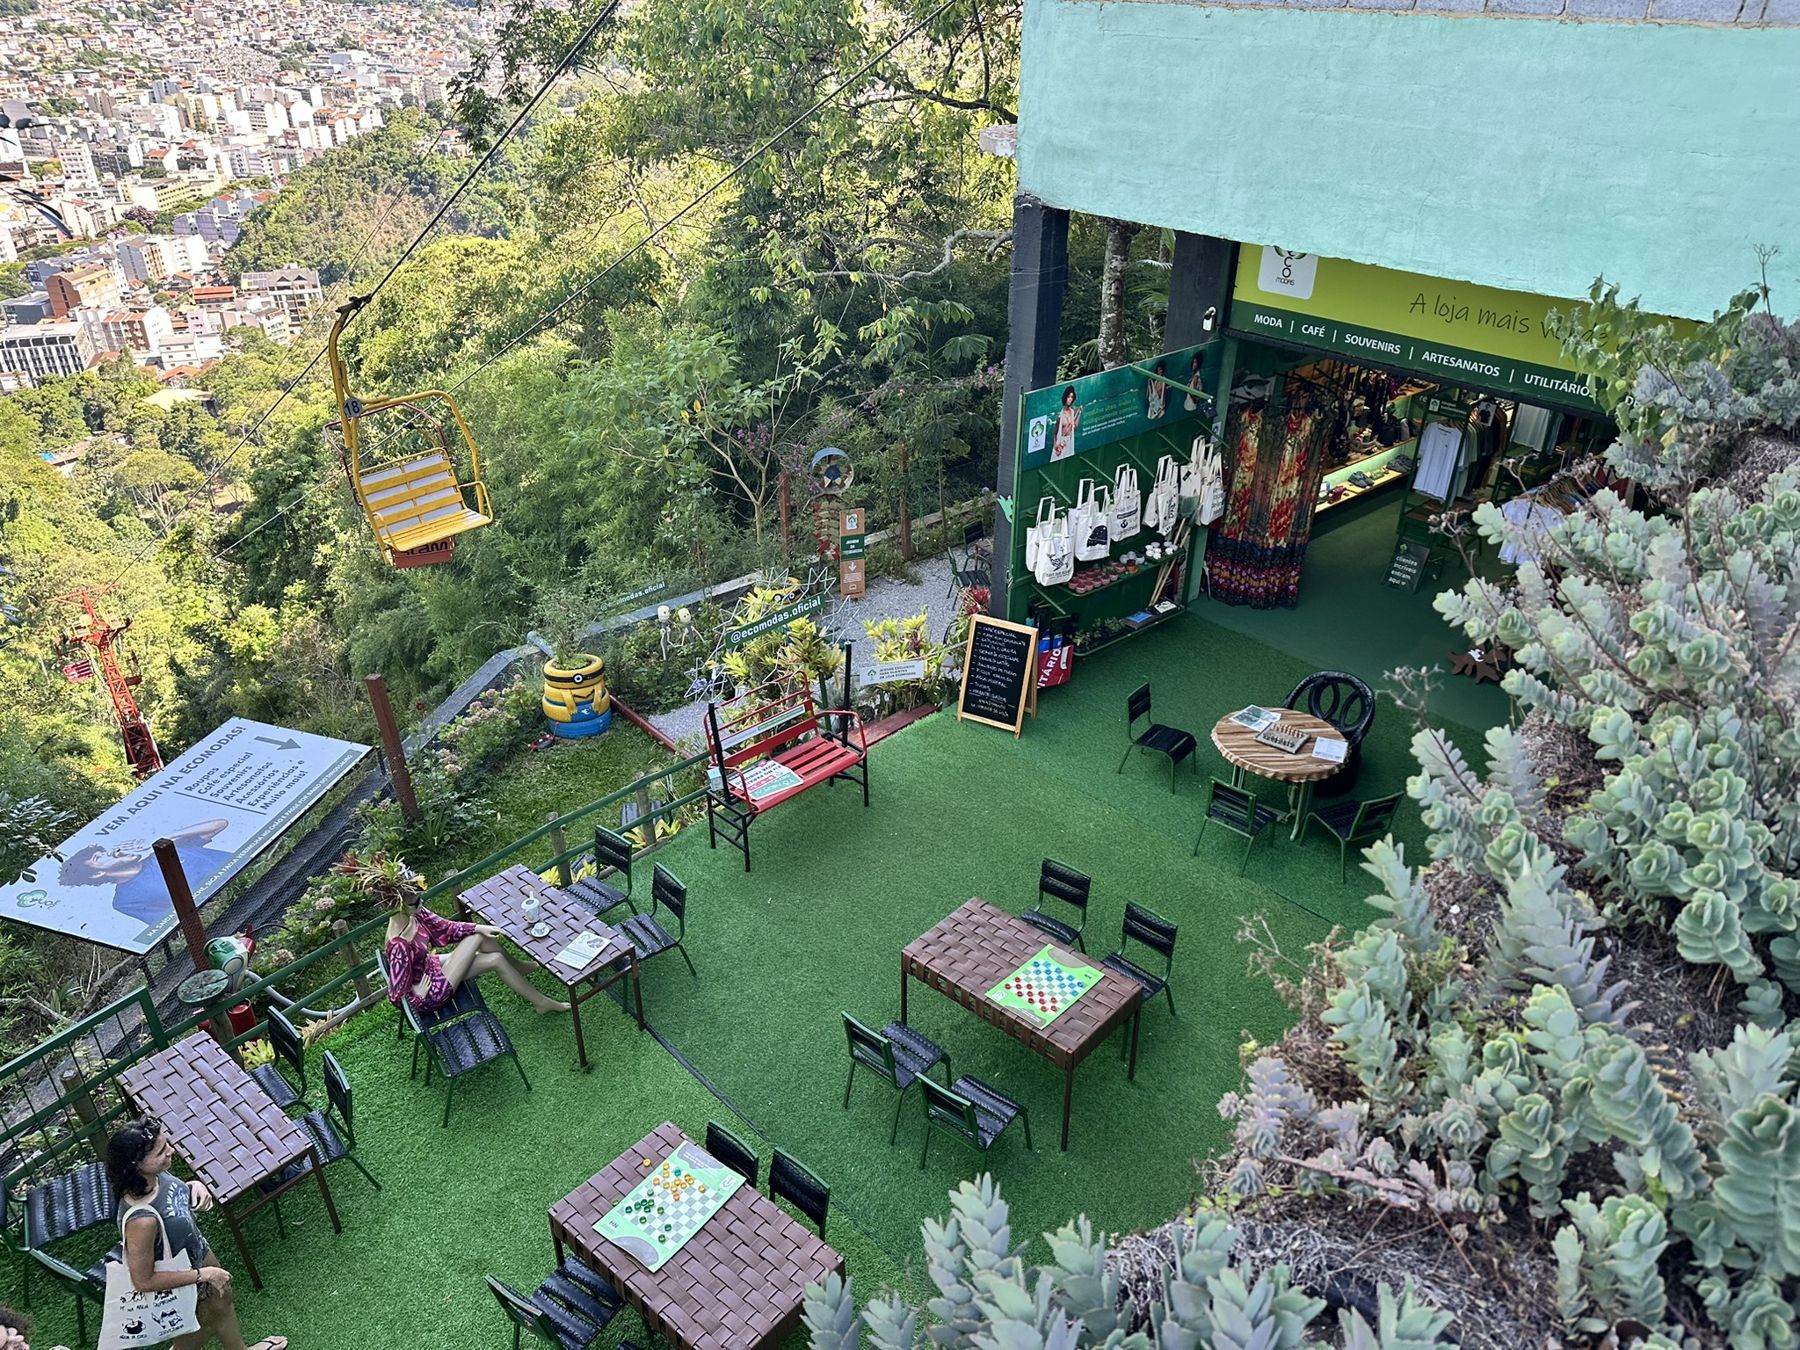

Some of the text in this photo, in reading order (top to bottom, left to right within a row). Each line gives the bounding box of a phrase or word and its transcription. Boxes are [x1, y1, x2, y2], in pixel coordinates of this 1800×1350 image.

[1409, 293, 1427, 315] A
[1434, 295, 1469, 323] loja
[1477, 307, 1530, 334] mais
[1254, 314, 1283, 329] MODA
[1301, 322, 1325, 338] CAFÉ
[1344, 333, 1401, 354] SOUVENIRS
[1421, 351, 1500, 377] ARTESANATOS
[344, 400, 360, 416] 18
[730, 596, 822, 644] @ecomodas.oficial
[95, 725, 247, 837] VEM AQUI NA ECOMODAS!
[186, 767, 220, 792] Roupas
[197, 751, 254, 795] Café especial
[210, 765, 253, 798] Souvenirs
[222, 761, 273, 801] Artesanatos
[235, 768, 279, 804] Acessórios
[247, 765, 300, 807] Experiências
[260, 770, 308, 810] Muito mais!
[166, 1181, 178, 1216] ALWAYS
